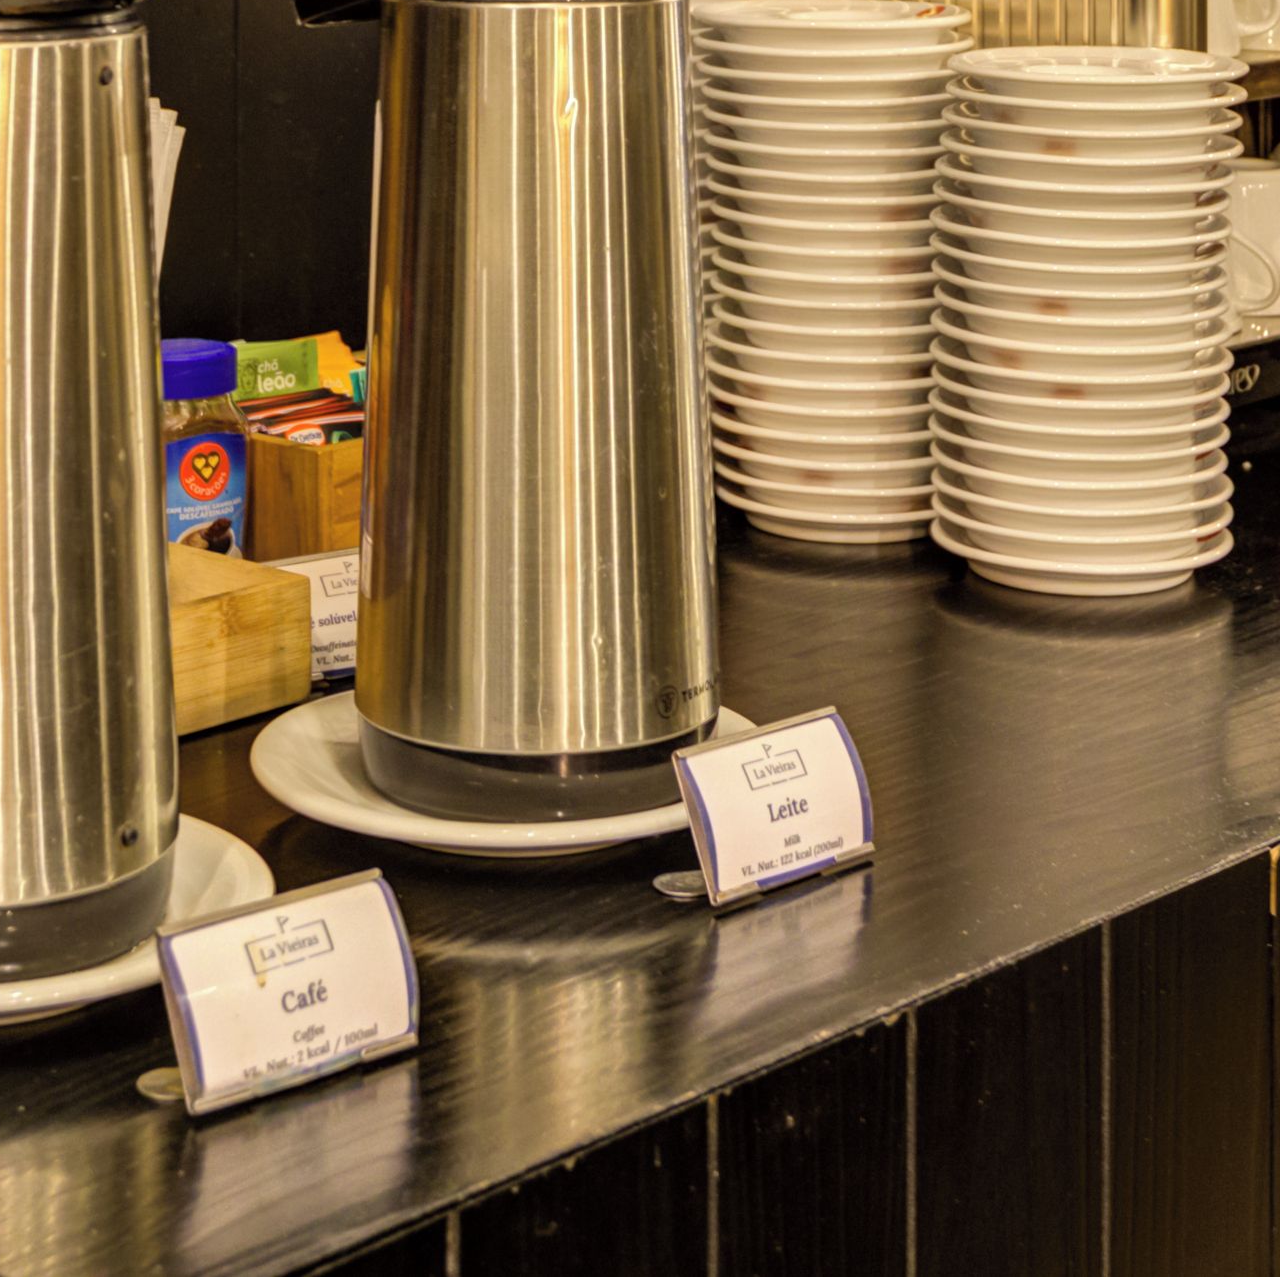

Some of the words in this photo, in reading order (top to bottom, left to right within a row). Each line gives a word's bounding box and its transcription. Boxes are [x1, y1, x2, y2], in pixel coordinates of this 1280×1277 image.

[257, 358, 279, 374] chá
[256, 371, 297, 394] leão
[342, 576, 358, 588] Vie
[318, 610, 357, 628] solúvel
[753, 767, 766, 780] La
[765, 759, 797, 778] Vieiras
[767, 796, 809, 824] Leite
[259, 947, 276, 962] La
[276, 934, 320, 957] Vieiras
[281, 978, 329, 1014] Café
